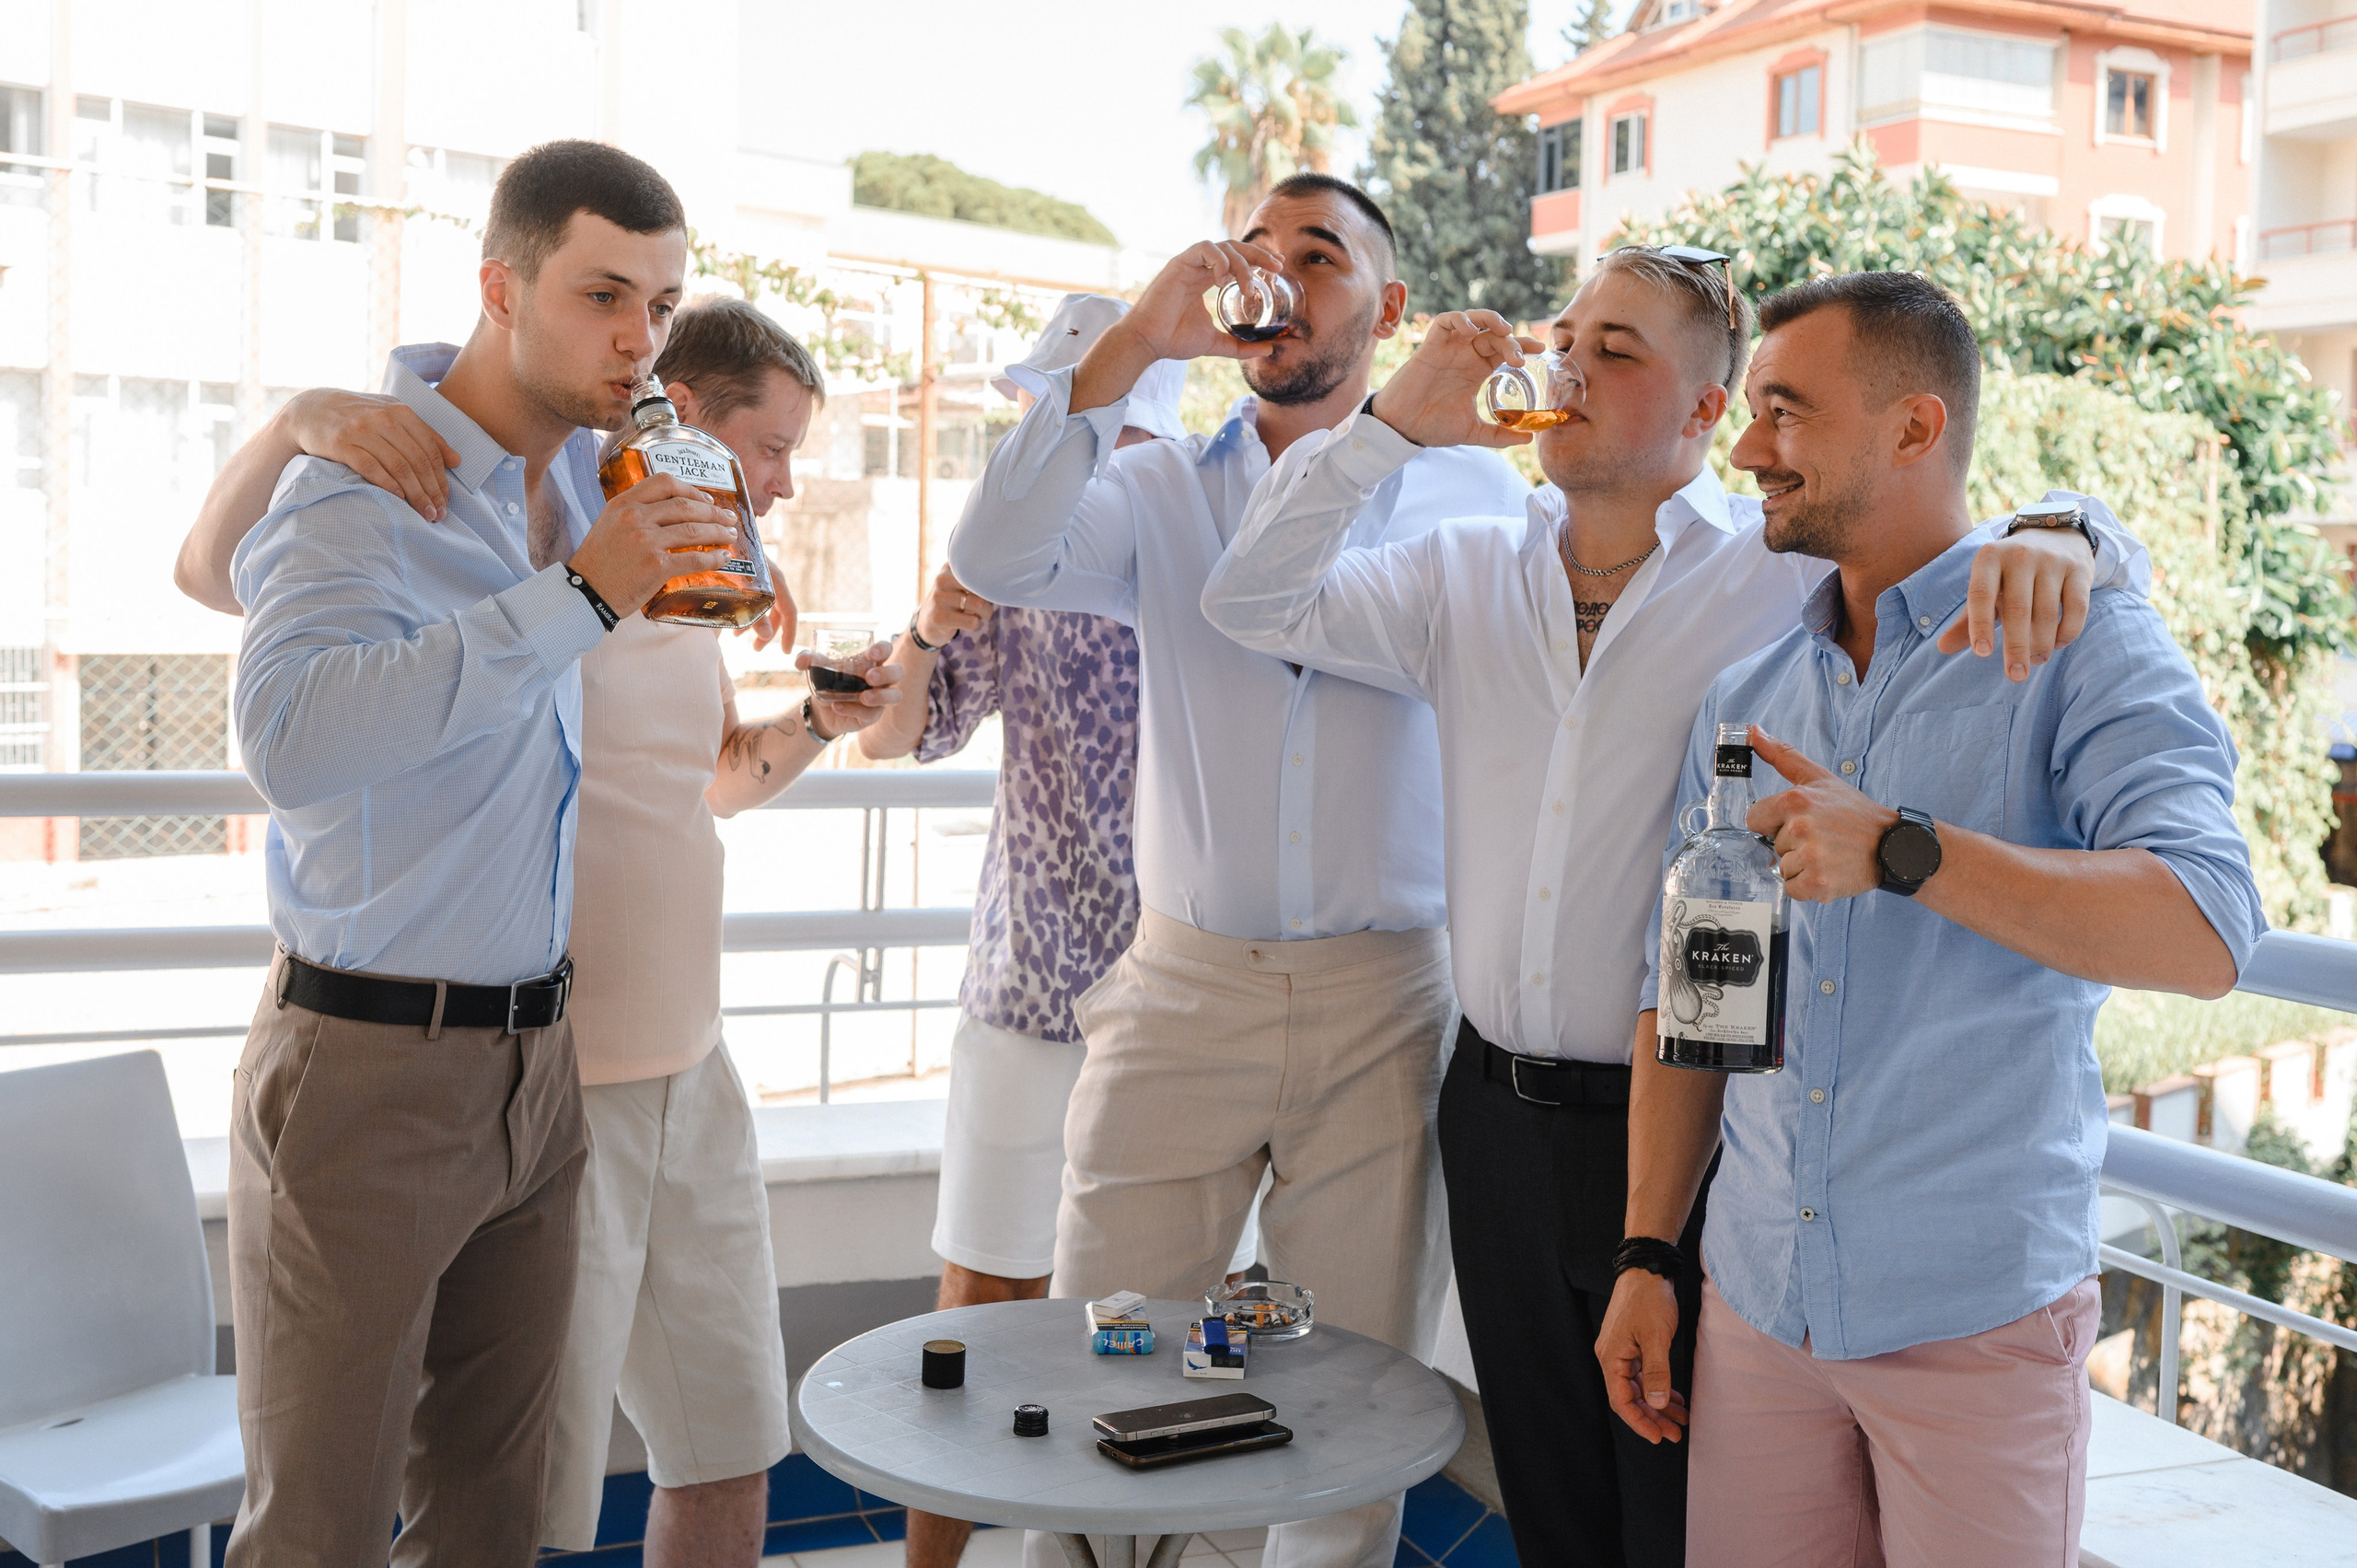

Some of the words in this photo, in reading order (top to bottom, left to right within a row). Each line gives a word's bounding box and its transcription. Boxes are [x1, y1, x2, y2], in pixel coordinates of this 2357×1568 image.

[655, 453, 726, 471] GENTLEMAN
[679, 465, 708, 478] JACK
[1713, 942, 1730, 951] The
[1691, 950, 1751, 964] KRAKEN
[1102, 1338, 1144, 1350] CAMEL
